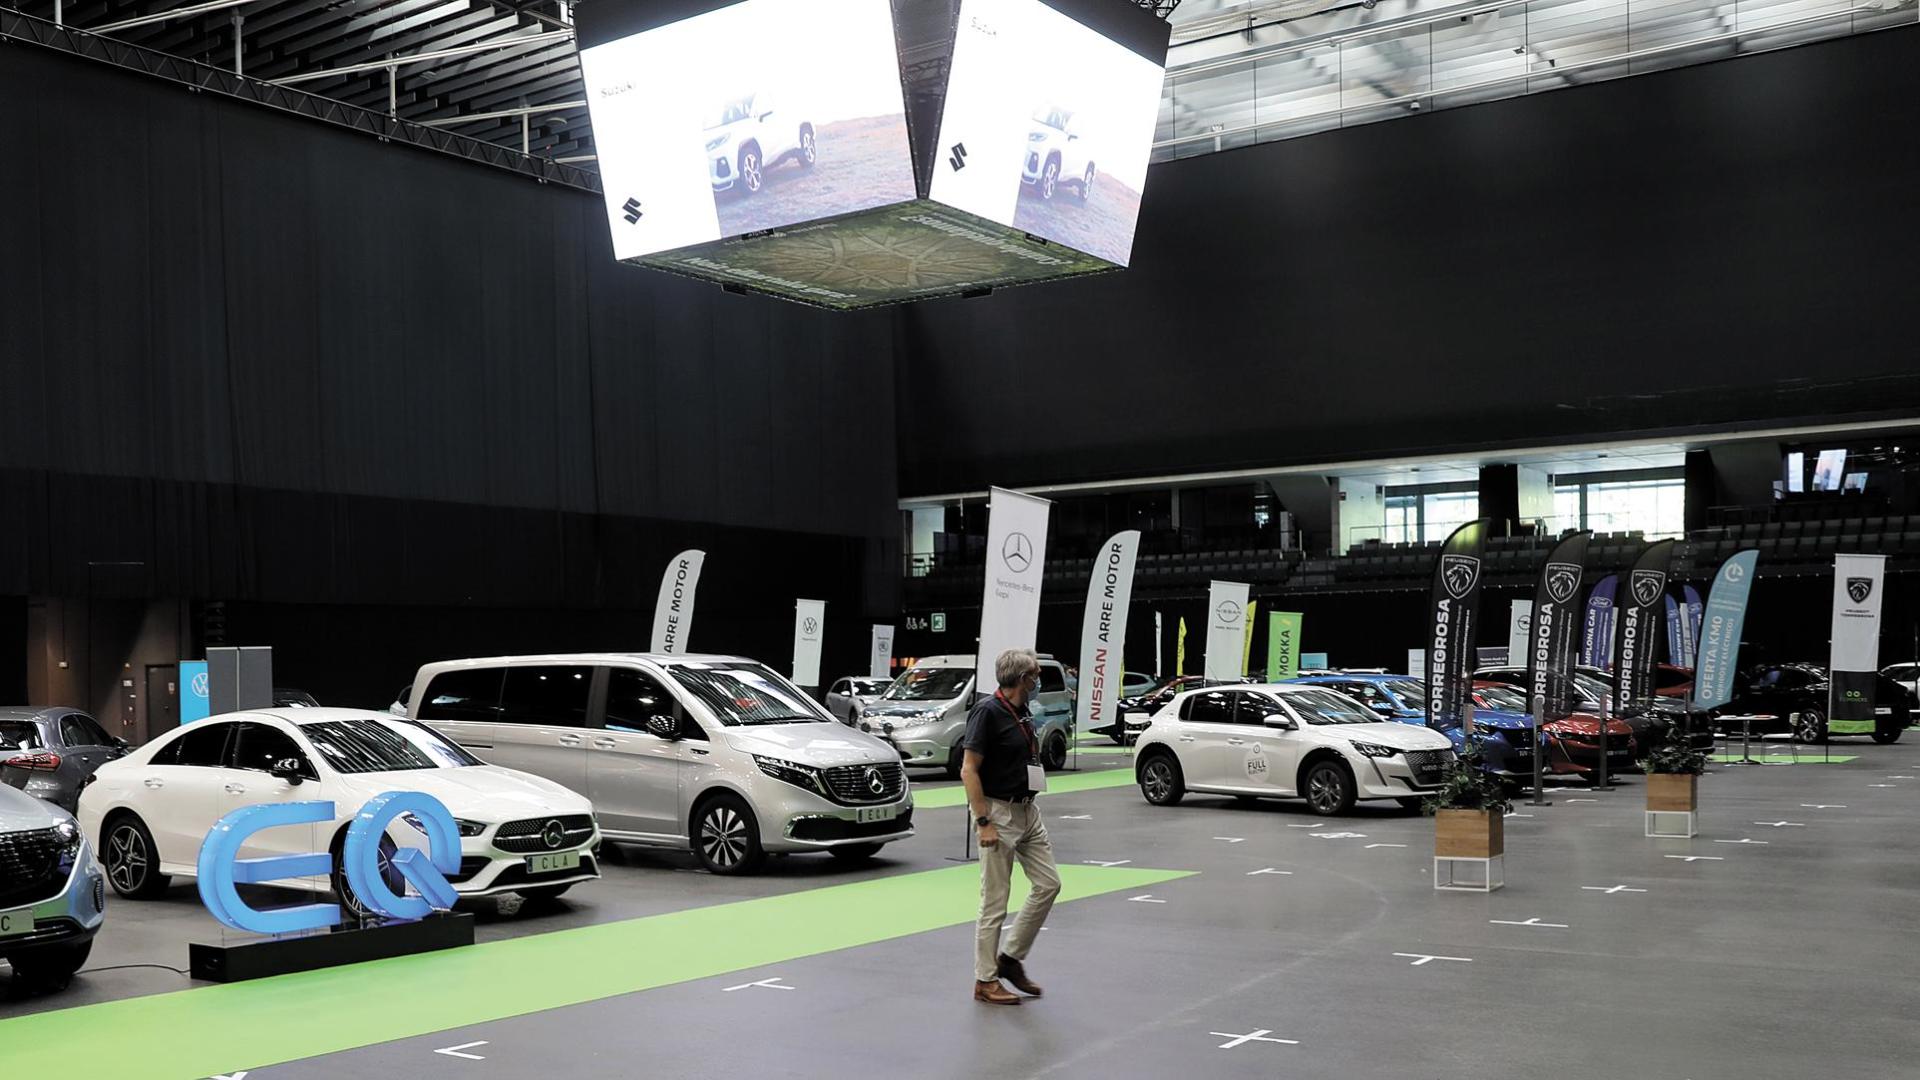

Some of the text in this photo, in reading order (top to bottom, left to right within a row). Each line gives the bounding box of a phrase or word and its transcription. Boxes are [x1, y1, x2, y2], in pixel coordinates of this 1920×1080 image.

[663, 559, 690, 653] ARRE MOTOR
[1090, 542, 1122, 721] NISSAN ARRE MOTOR
[1588, 608, 1597, 627] CAR
[1279, 630, 1291, 676] MOKKA
[1431, 598, 1451, 724] TORREGROSA
[1534, 602, 1554, 712] ORREGROSA
[1620, 606, 1640, 711] TORREGROSA
[1701, 648, 1718, 700] OFERTA
[1248, 760, 1267, 770] FULL
[542, 855, 569, 870] CLA
